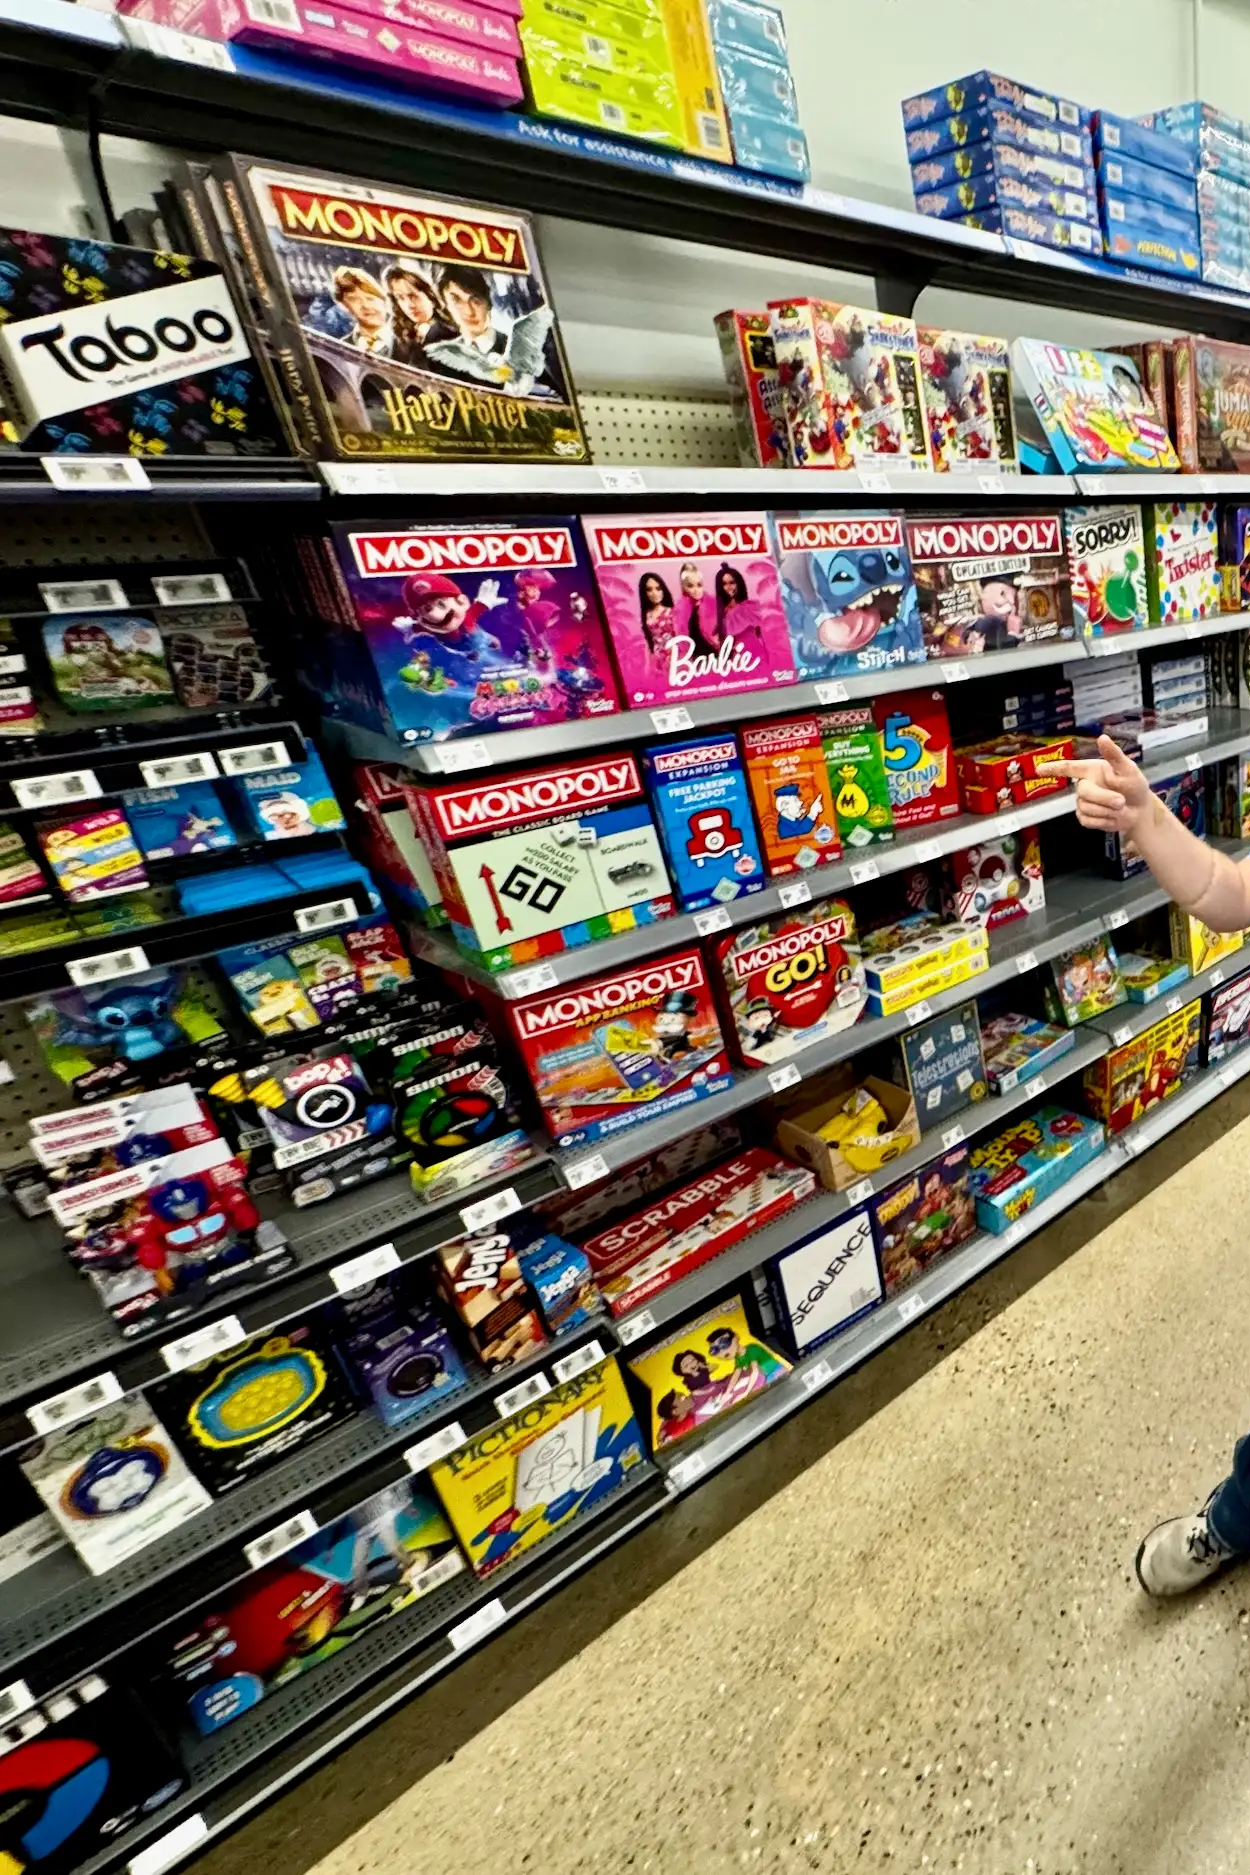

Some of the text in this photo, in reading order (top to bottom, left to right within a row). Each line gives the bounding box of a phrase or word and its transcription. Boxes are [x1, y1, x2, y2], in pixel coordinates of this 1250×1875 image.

[518, 120, 667, 169] Ask for assistance
[281, 191, 517, 264] MONOPOLY
[21, 309, 234, 384] Taboo
[383, 386, 528, 437] Harry Potter
[601, 525, 763, 559] MONOPOLY
[782, 521, 899, 548] MONOPOLY
[914, 522, 1058, 558] MONOPOLY
[1074, 517, 1139, 554] SORRY!
[363, 534, 567, 572] MONOPOLY
[1165, 549, 1214, 584] Twister
[665, 634, 760, 686] Barbie
[856, 646, 905, 670] Stitch
[748, 723, 815, 746] MONOPOLY
[818, 708, 871, 728] ONOPOLY
[820, 723, 866, 738] PANSION
[659, 744, 735, 770] MONOPOLY
[756, 737, 811, 755] EXPANSION
[884, 711, 922, 772] 5
[243, 771, 302, 789] MAID
[668, 762, 730, 780] EXPANSION
[668, 776, 737, 798] FREE PARKING
[886, 764, 940, 789] ECOND
[450, 765, 630, 827] MONOPOLY
[682, 787, 727, 804] JACKPOT
[492, 805, 610, 839] THE CLASSIC BOARD GAME
[522, 855, 533, 865] AS
[540, 842, 576, 864] COLLECT
[549, 855, 581, 876] SALARY
[499, 864, 567, 915] GO
[738, 919, 846, 976] MONOPOLY
[764, 949, 829, 994] GO!
[526, 962, 695, 1033] MONOPOLY
[575, 995, 662, 1028] APP BANKING
[391, 1025, 464, 1057] simon
[405, 1060, 480, 1097] simon
[599, 1160, 752, 1253] SCRABBLE
[539, 1266, 580, 1302] Jenga
[617, 1271, 672, 1310] SCRABBLE
[791, 1221, 872, 1327] SEQUENCE
[444, 1370, 606, 1476] PICTIONARY
